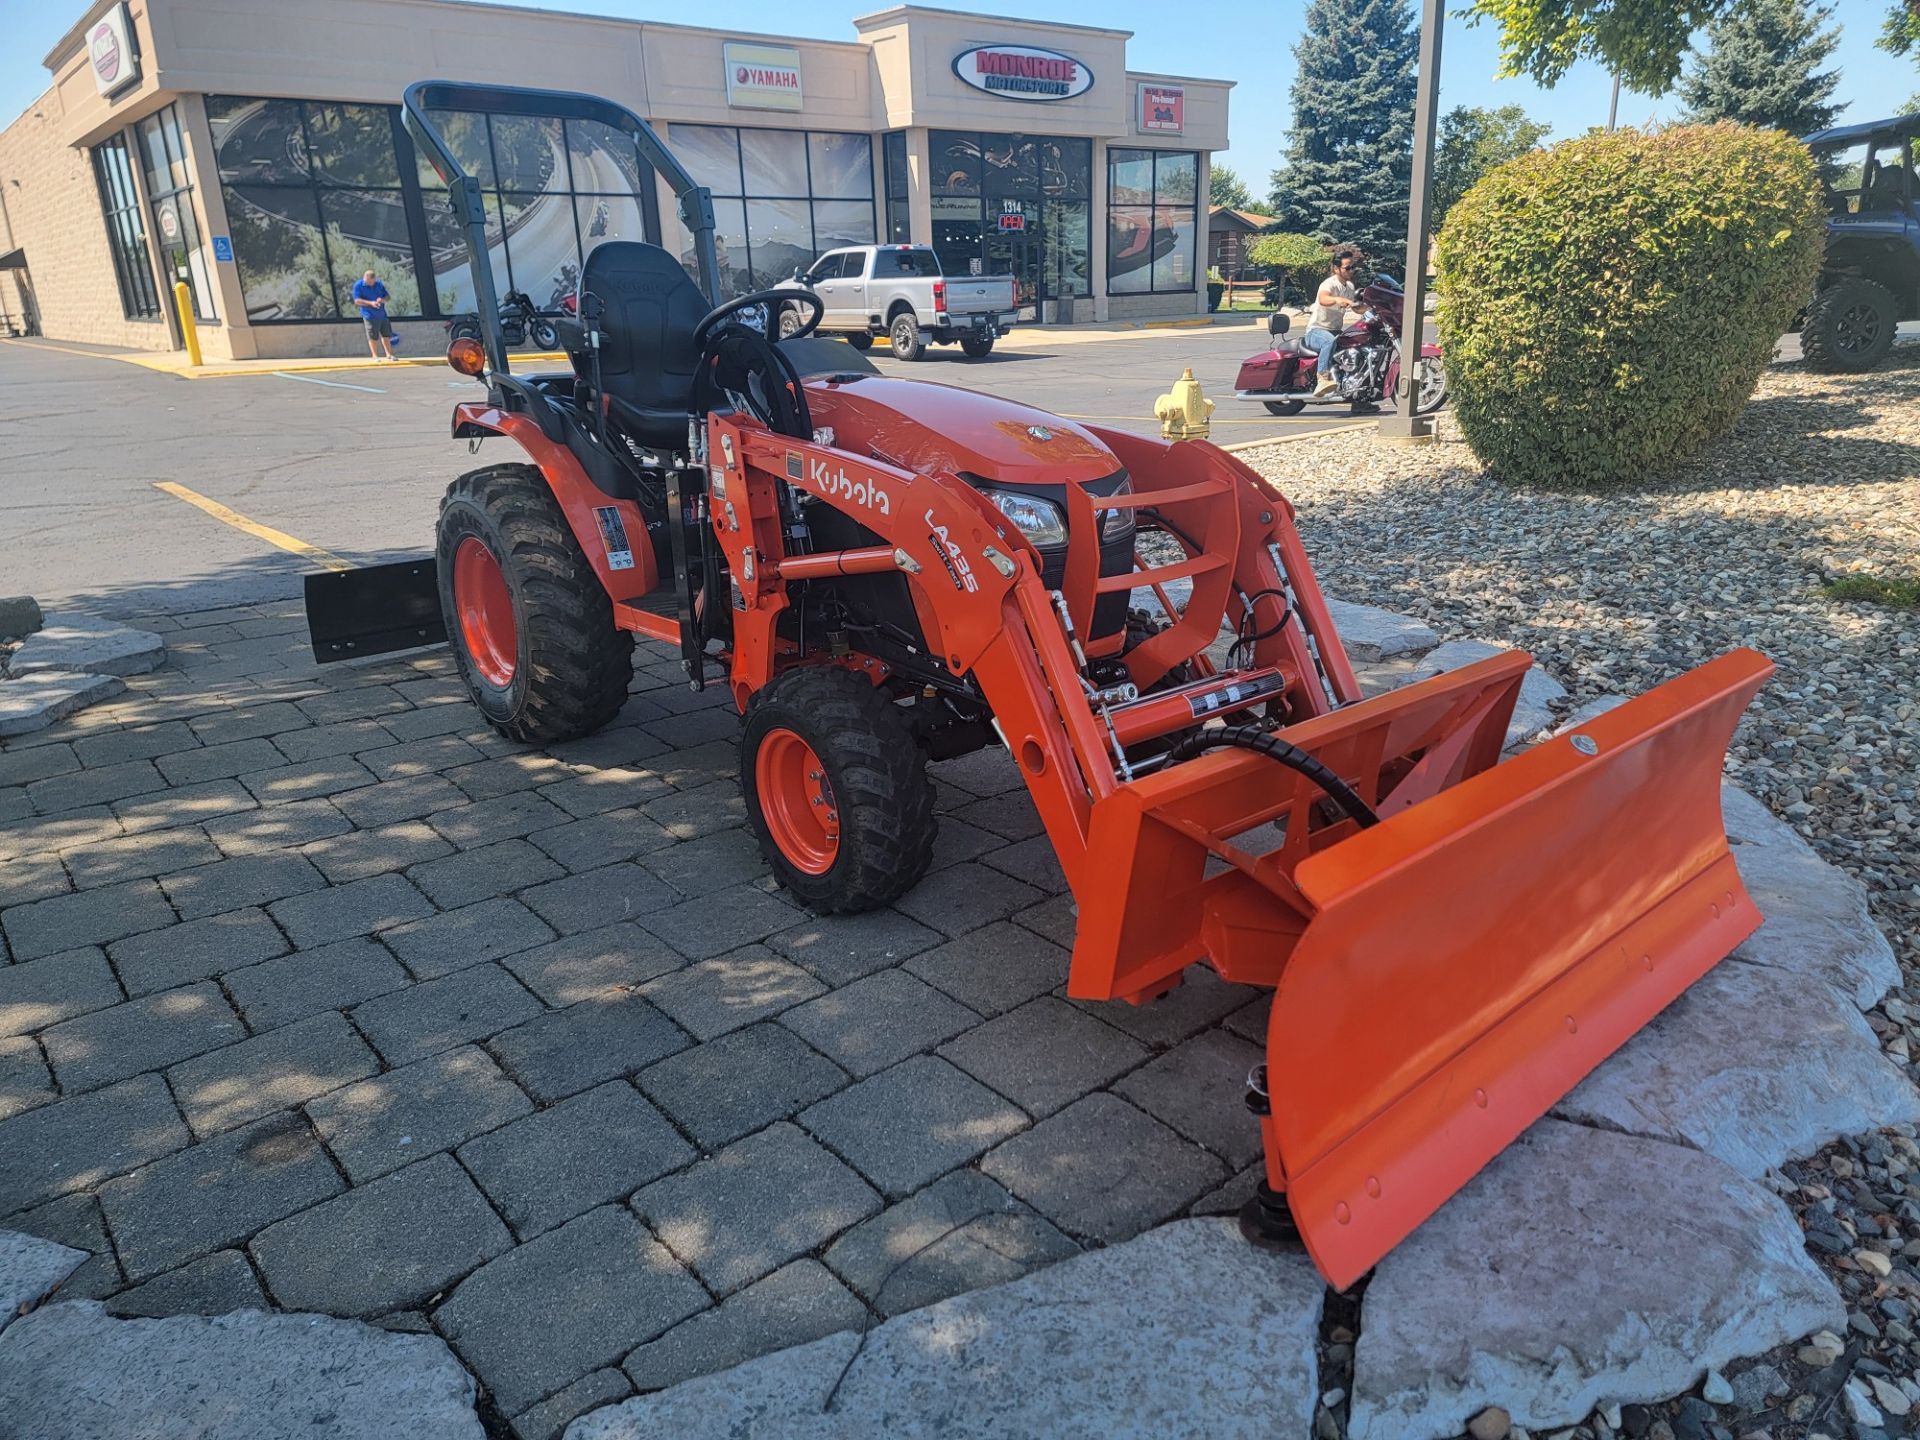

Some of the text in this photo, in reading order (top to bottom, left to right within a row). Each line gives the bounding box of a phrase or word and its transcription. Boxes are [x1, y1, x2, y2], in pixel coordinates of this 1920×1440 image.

[976, 51, 1077, 82] MONROE
[750, 69, 798, 88] YAMAHA
[985, 75, 1070, 95] MOTORSPORTS
[1003, 201, 1021, 213] 1314
[1000, 215, 1024, 230] OPEN
[810, 458, 890, 515] Kubota
[924, 508, 979, 593] LA435
